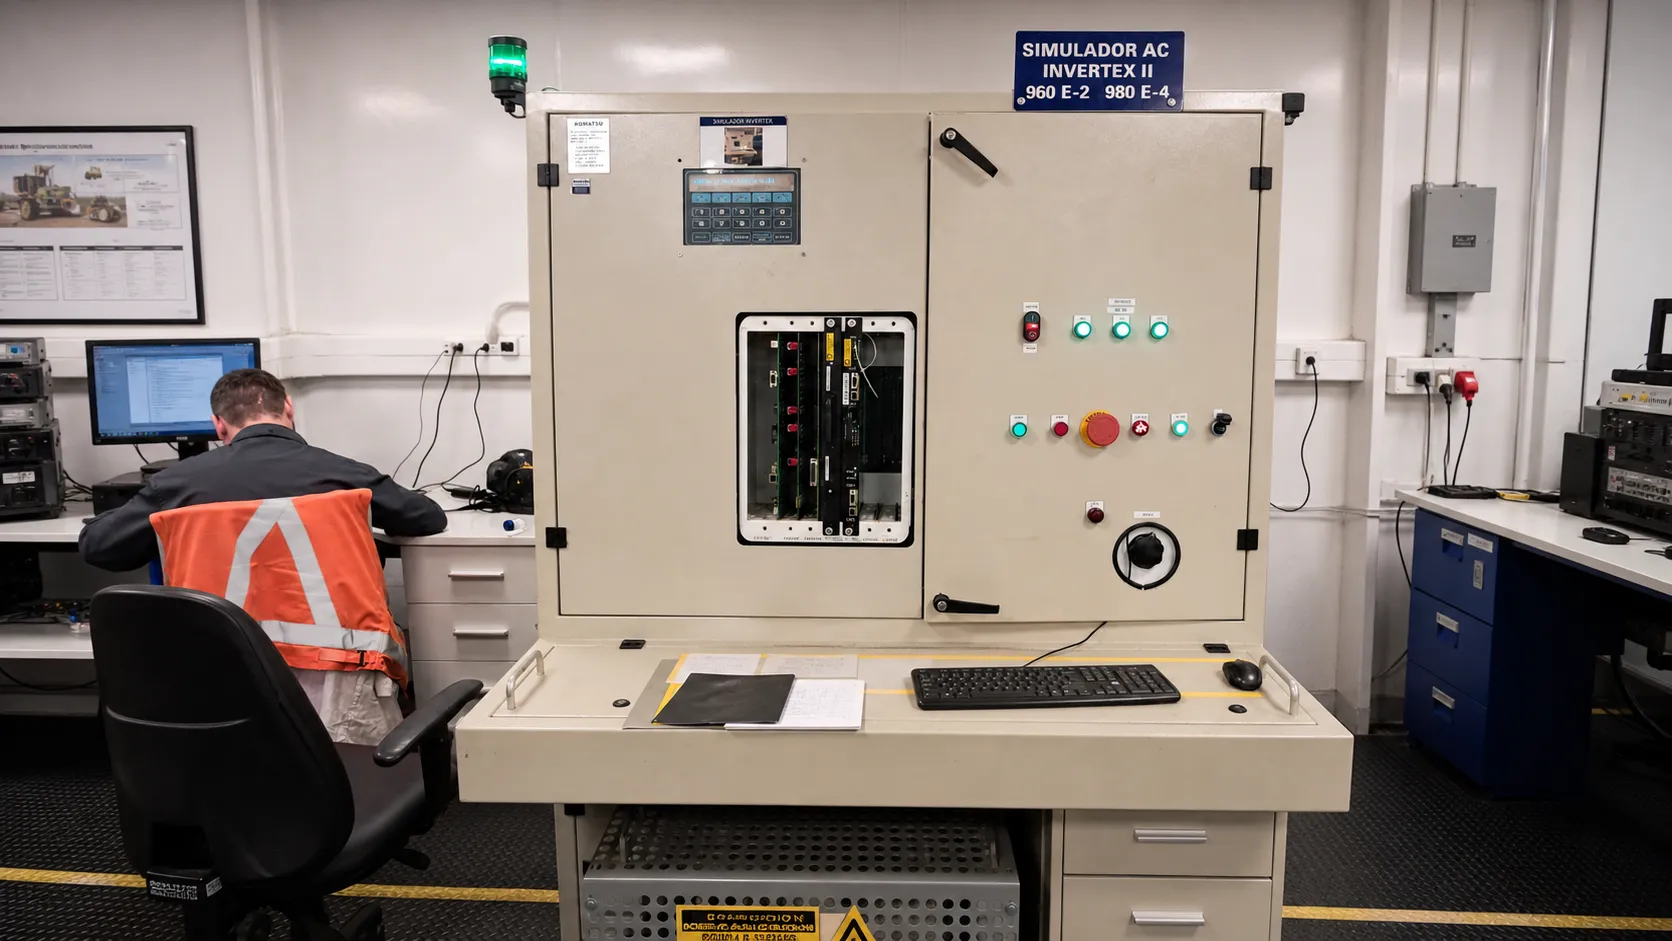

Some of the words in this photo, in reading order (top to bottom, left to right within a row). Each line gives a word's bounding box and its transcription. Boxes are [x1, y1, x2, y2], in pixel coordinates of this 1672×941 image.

[1022, 42, 1138, 58] SIMULADOR
[1142, 42, 1170, 58] AC
[1043, 63, 1136, 78] INVERTEX
[1141, 63, 1153, 78] II
[1026, 85, 1056, 99] 960
[1061, 85, 1090, 99] E-2
[1105, 85, 1136, 99] 980
[1141, 85, 1170, 99] E-4
